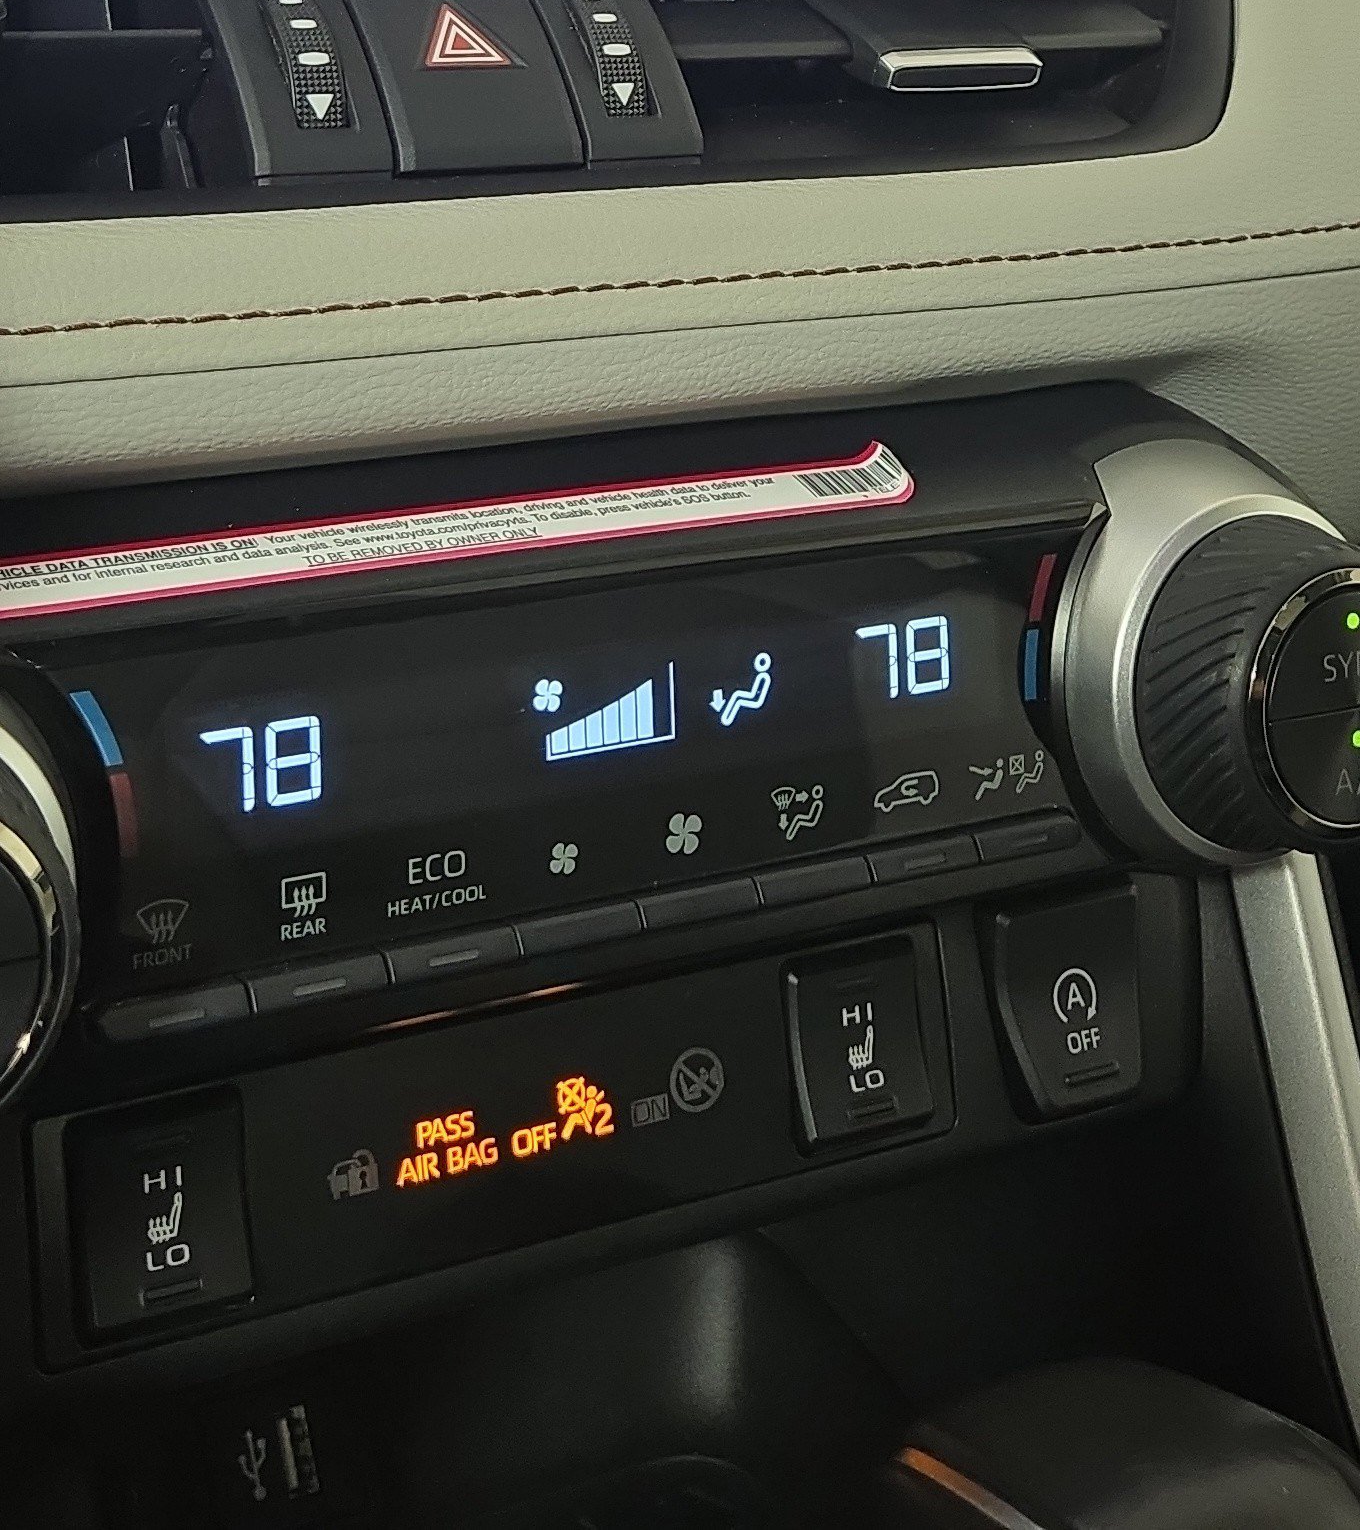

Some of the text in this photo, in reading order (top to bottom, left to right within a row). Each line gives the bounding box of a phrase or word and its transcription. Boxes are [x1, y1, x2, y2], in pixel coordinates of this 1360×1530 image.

[43, 573, 70, 586] and
[74, 570, 93, 582] for
[95, 563, 148, 579] internal
[150, 556, 211, 573] research
[214, 552, 240, 564] and
[242, 548, 272, 561] data
[275, 540, 332, 557] analysis.
[333, 536, 361, 548] See
[533, 512, 549, 523] To
[550, 507, 597, 521] disable,
[597, 503, 631, 516] press
[631, 497, 682, 511] vehicle's
[682, 493, 710, 505] SOS
[711, 489, 751, 502] button.
[46, 559, 89, 573] DATA
[92, 543, 207, 568] TRANSMISSION
[212, 541, 228, 552] IS
[264, 533, 296, 545] Your
[298, 526, 345, 540] vehicle
[347, 518, 408, 535] wirelessly
[411, 510, 469, 526] transmits
[469, 505, 523, 519] location,
[524, 500, 564, 512] driving
[566, 496, 589, 507] and
[591, 492, 631, 504] vehicle
[632, 488, 669, 500] health
[670, 485, 695, 496] data
[697, 483, 710, 493] to
[711, 479, 748, 491] deliver
[748, 477, 774, 488] your
[302, 526, 540, 566] TO BE REMOVED BY OWNER ONLY
[855, 614, 950, 699] 78
[199, 715, 322, 812] 78
[407, 850, 466, 885] ECO
[387, 884, 487, 918] HEAT/COOL
[280, 917, 327, 941] REAR
[132, 943, 192, 970] FRONT
[842, 1002, 873, 1027] HI
[1067, 1027, 1101, 1054] OFF
[849, 1069, 885, 1093] LO
[416, 1111, 475, 1148] PASS
[396, 1121, 558, 1188] AIR BAG OFF
[143, 1166, 183, 1193] HI
[146, 1243, 191, 1271] LO
